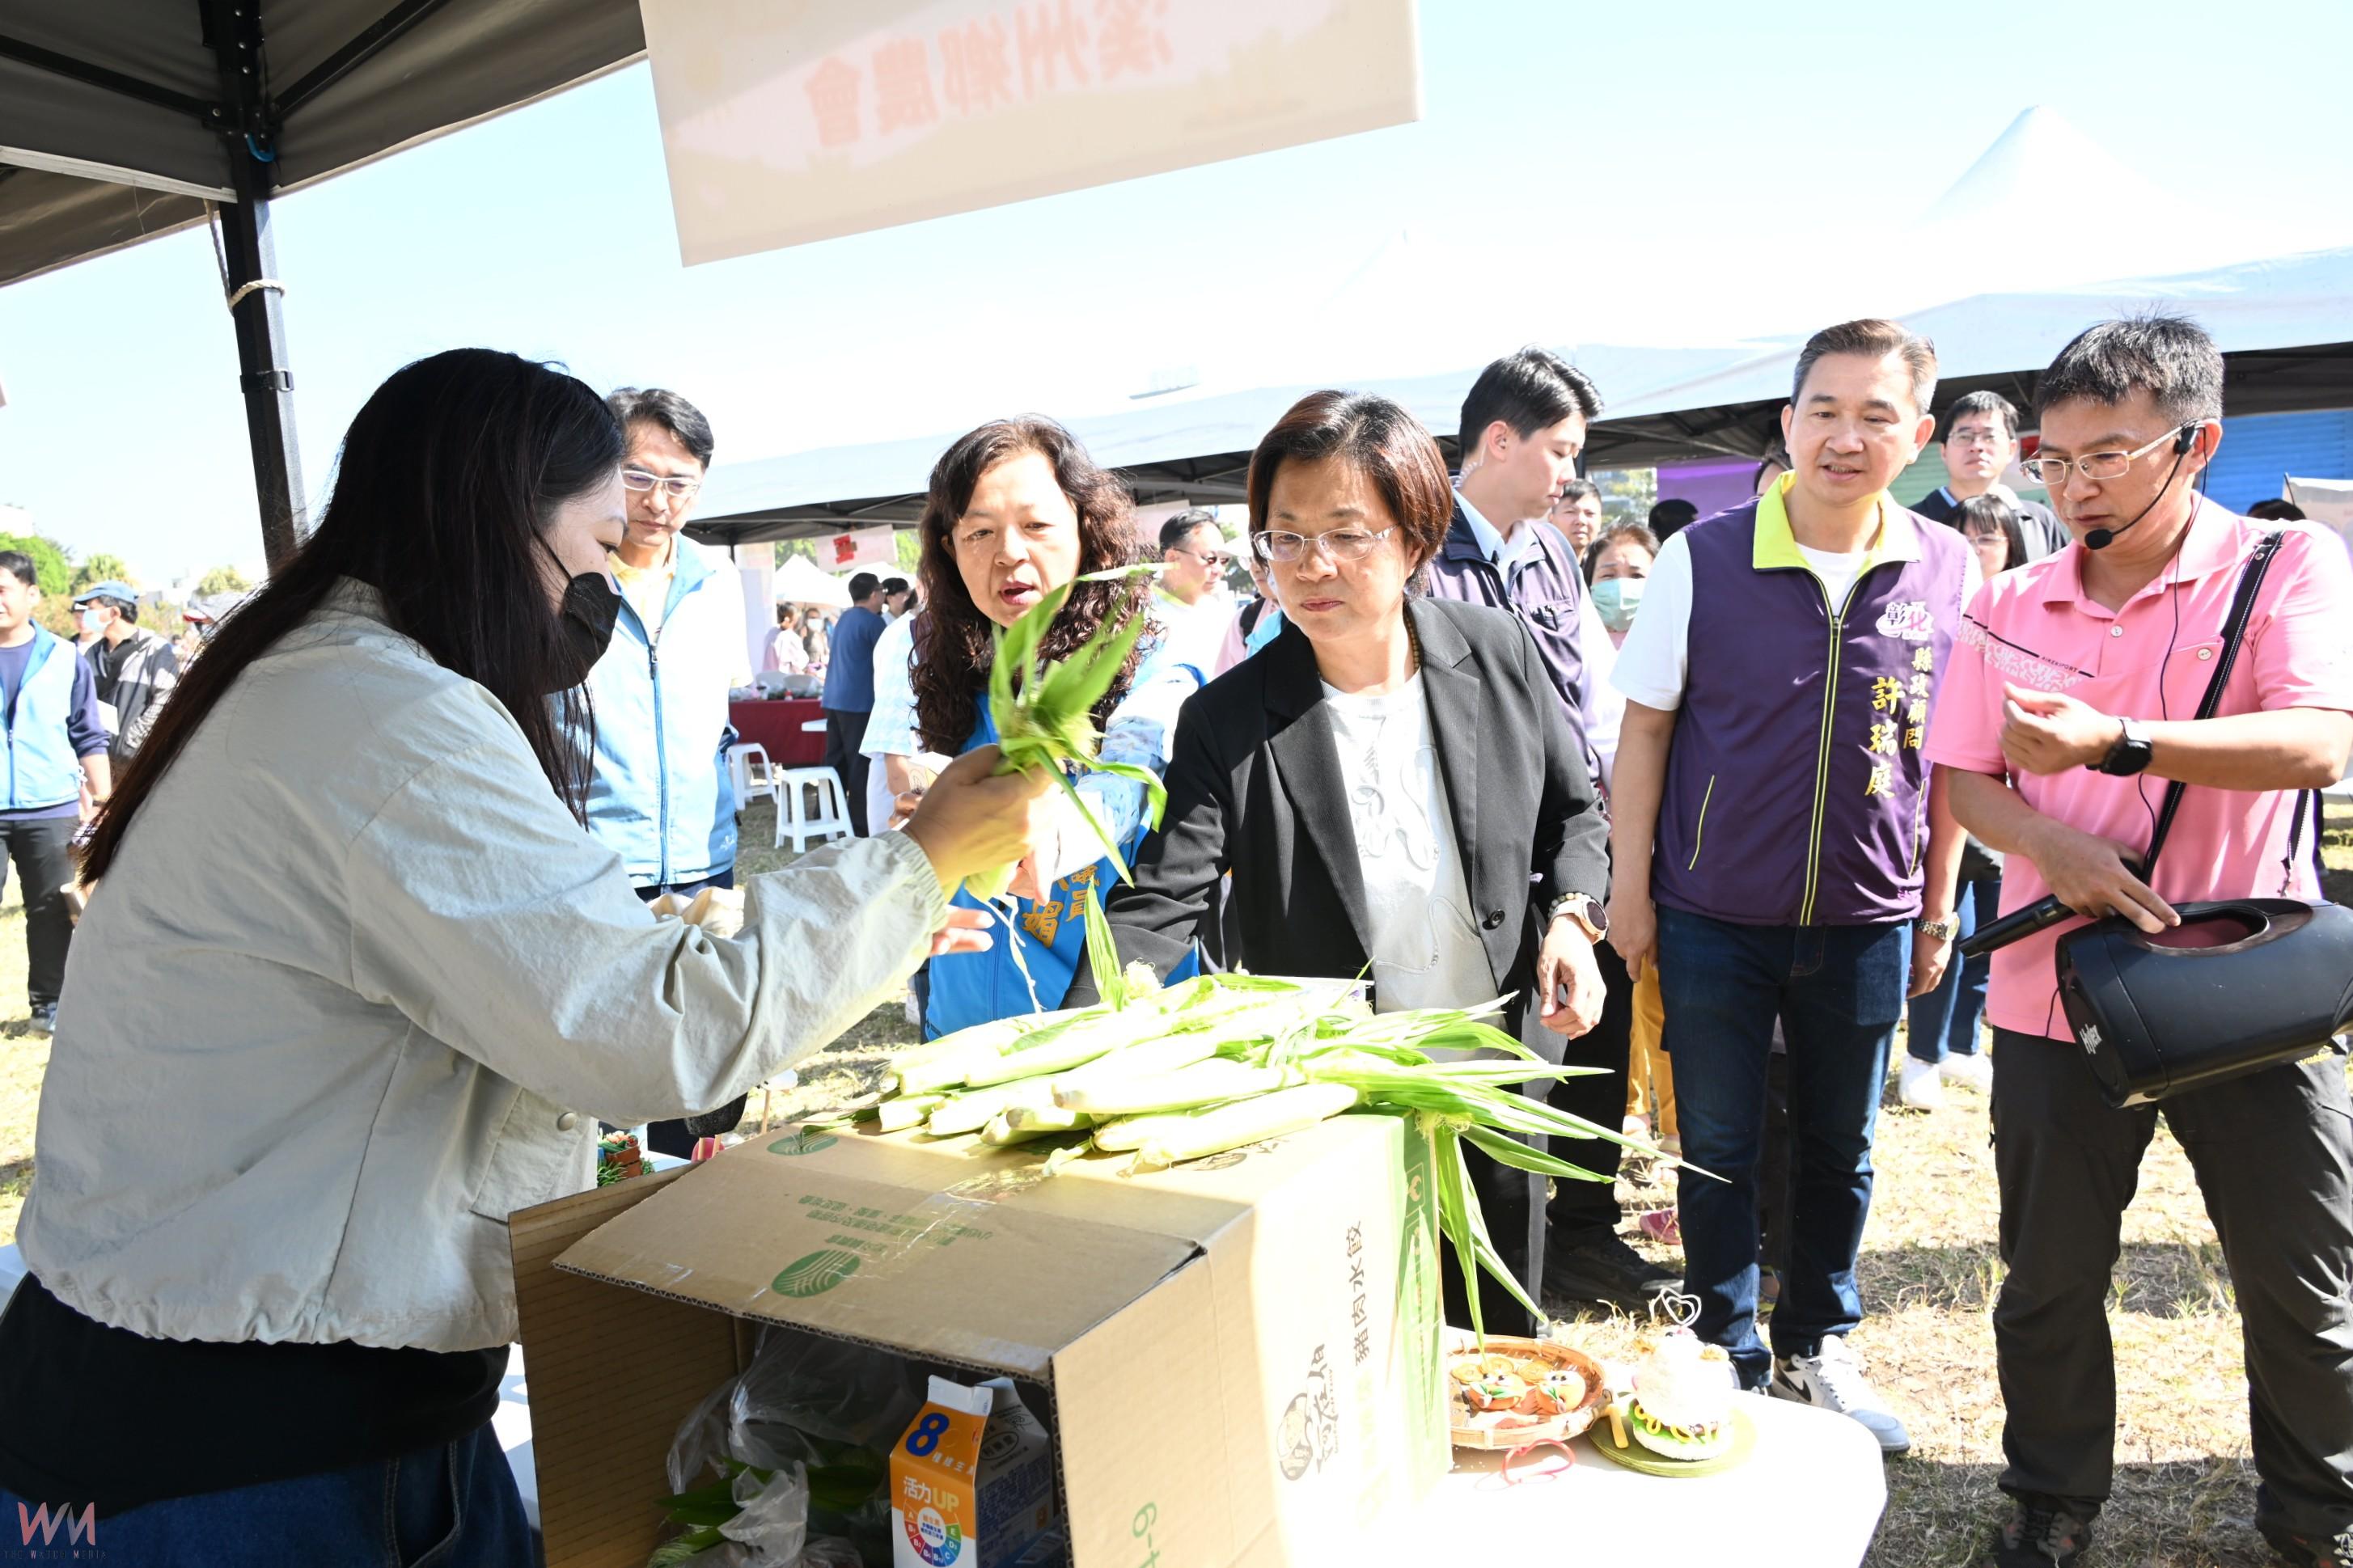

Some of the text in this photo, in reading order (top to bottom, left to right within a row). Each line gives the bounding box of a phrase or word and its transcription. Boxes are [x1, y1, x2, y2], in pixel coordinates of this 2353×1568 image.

[1885, 602, 1928, 632] 彰化
[1903, 647, 1932, 750] 縣政顧問
[1864, 676, 1906, 798] 許瑞庭
[2079, 1023, 2103, 1055] Hylex
[1346, 1220, 1370, 1367] 豬肉水餃
[905, 1412, 950, 1457] 8
